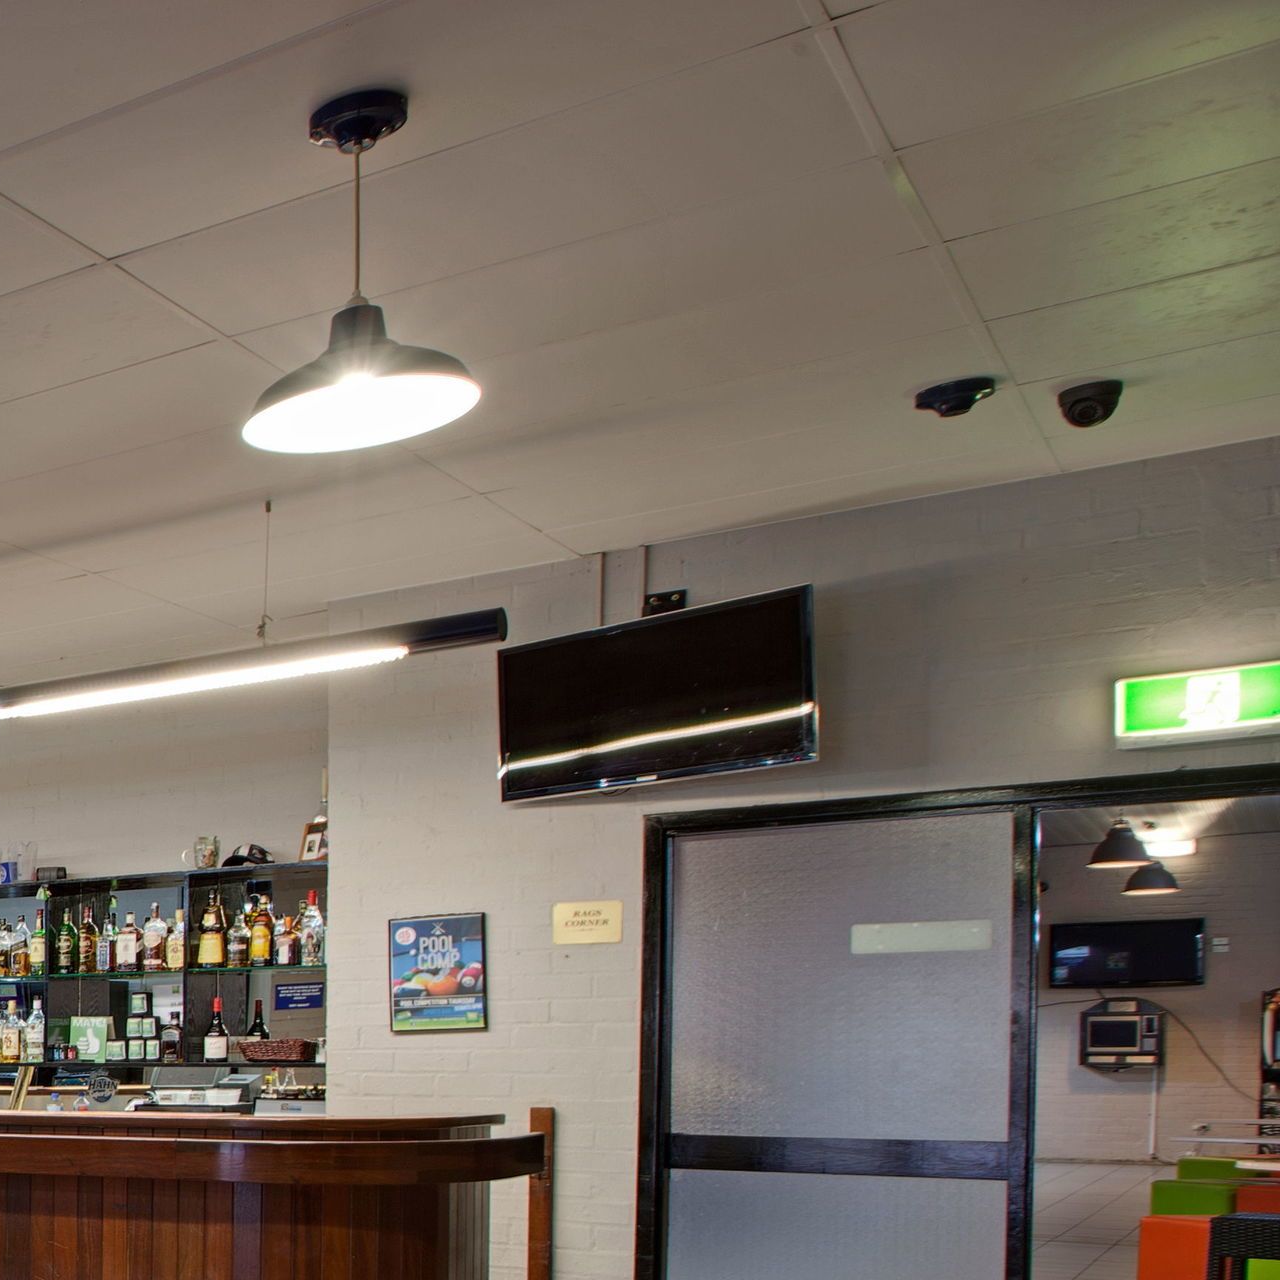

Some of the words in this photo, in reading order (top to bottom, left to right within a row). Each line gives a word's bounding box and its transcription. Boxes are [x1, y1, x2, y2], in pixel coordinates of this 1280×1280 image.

[572, 909, 602, 918] RAGS
[563, 918, 610, 928] CORNER
[419, 935, 458, 954] POOL
[418, 951, 461, 969] COMP
[88, 1077, 118, 1091] HAHN
